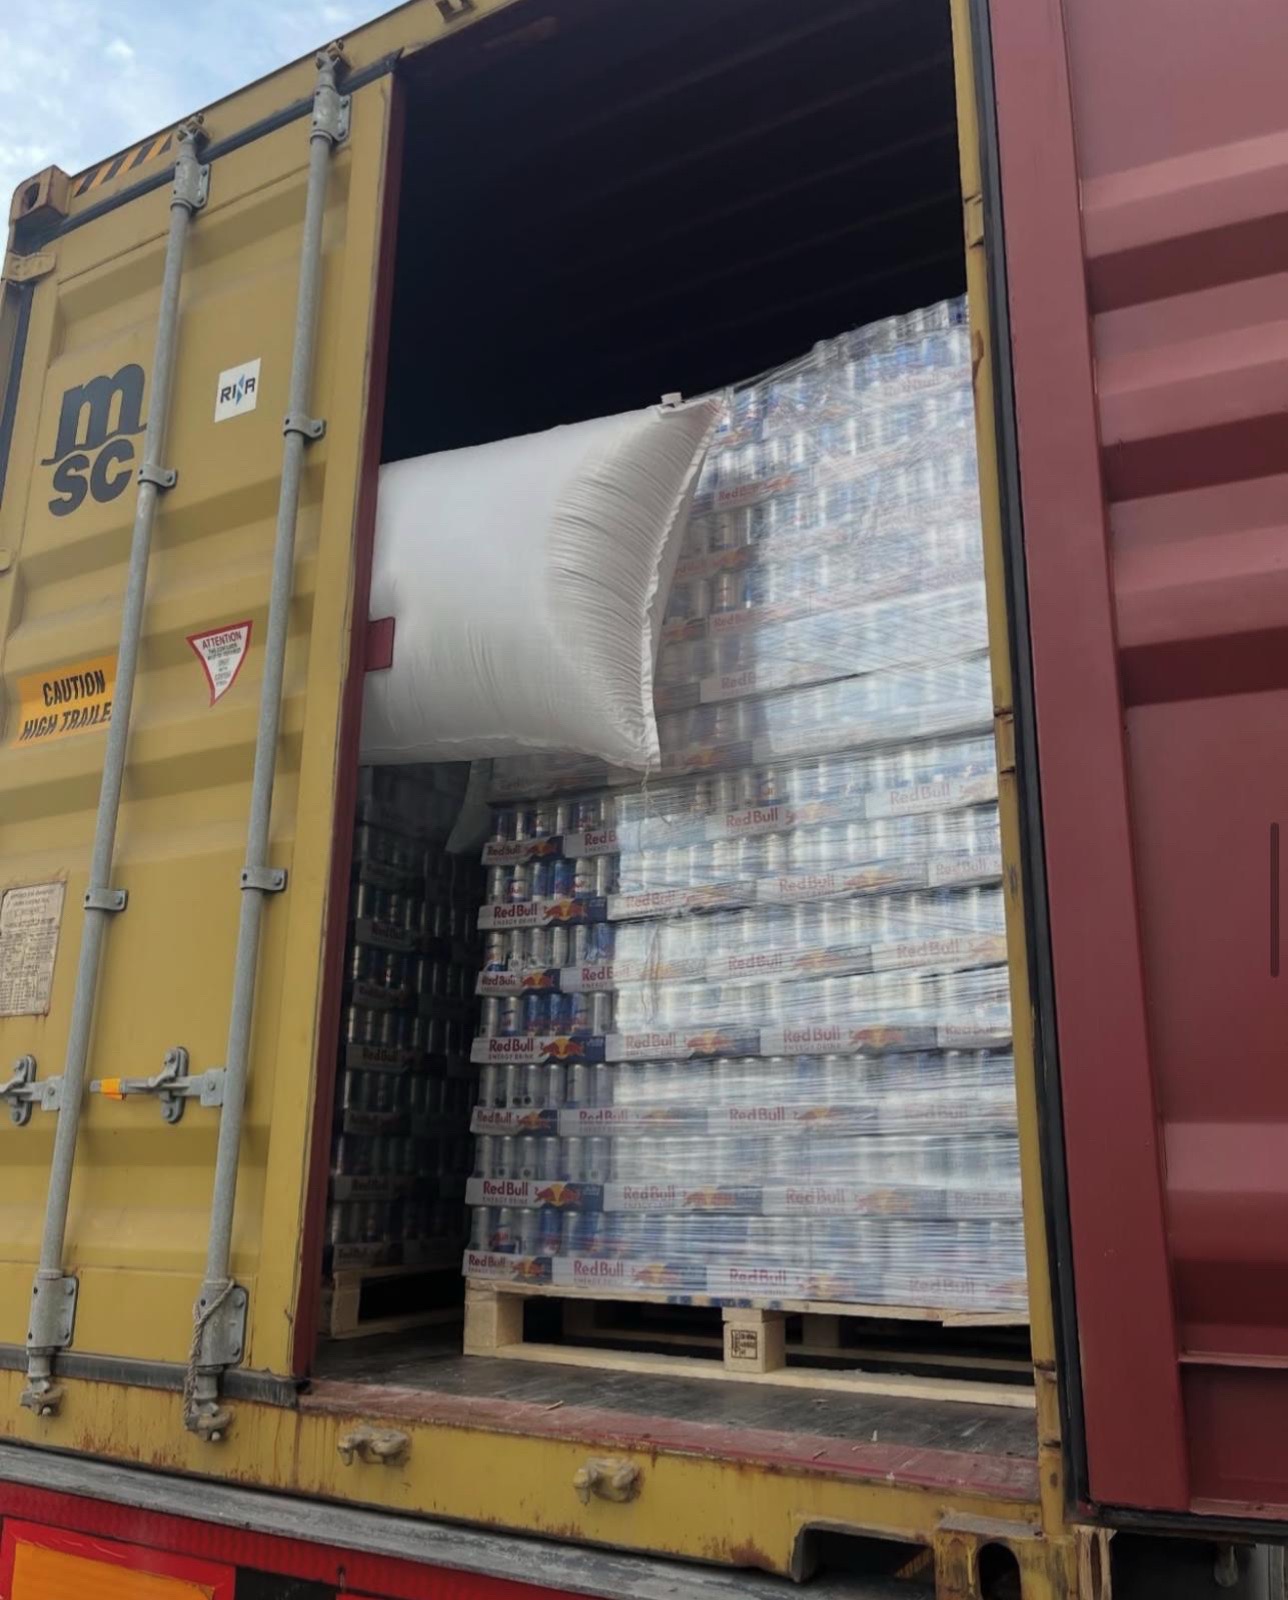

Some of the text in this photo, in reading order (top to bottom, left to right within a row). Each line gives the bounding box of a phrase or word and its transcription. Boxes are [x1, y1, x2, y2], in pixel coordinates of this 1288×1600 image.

[202, 631, 242, 650] ATTENTION
[43, 669, 105, 707] CAUTION
[19, 701, 112, 741] HIGH TRAILE
[726, 807, 778, 827] Red Bull
[584, 832, 607, 846] Red
[494, 903, 538, 919] Red Bull
[481, 974, 516, 986] Red Bull
[582, 967, 605, 982] Red
[625, 1032, 676, 1049] Red Bull
[784, 1026, 840, 1043] Red Bull
[489, 1038, 533, 1052] Red Bull
[477, 1110, 512, 1124] Red Bull
[729, 1106, 785, 1121] Red Bull
[483, 1181, 528, 1196] Red Bull
[468, 1254, 506, 1269] Red Bull
[573, 1260, 624, 1278] Red Bull
